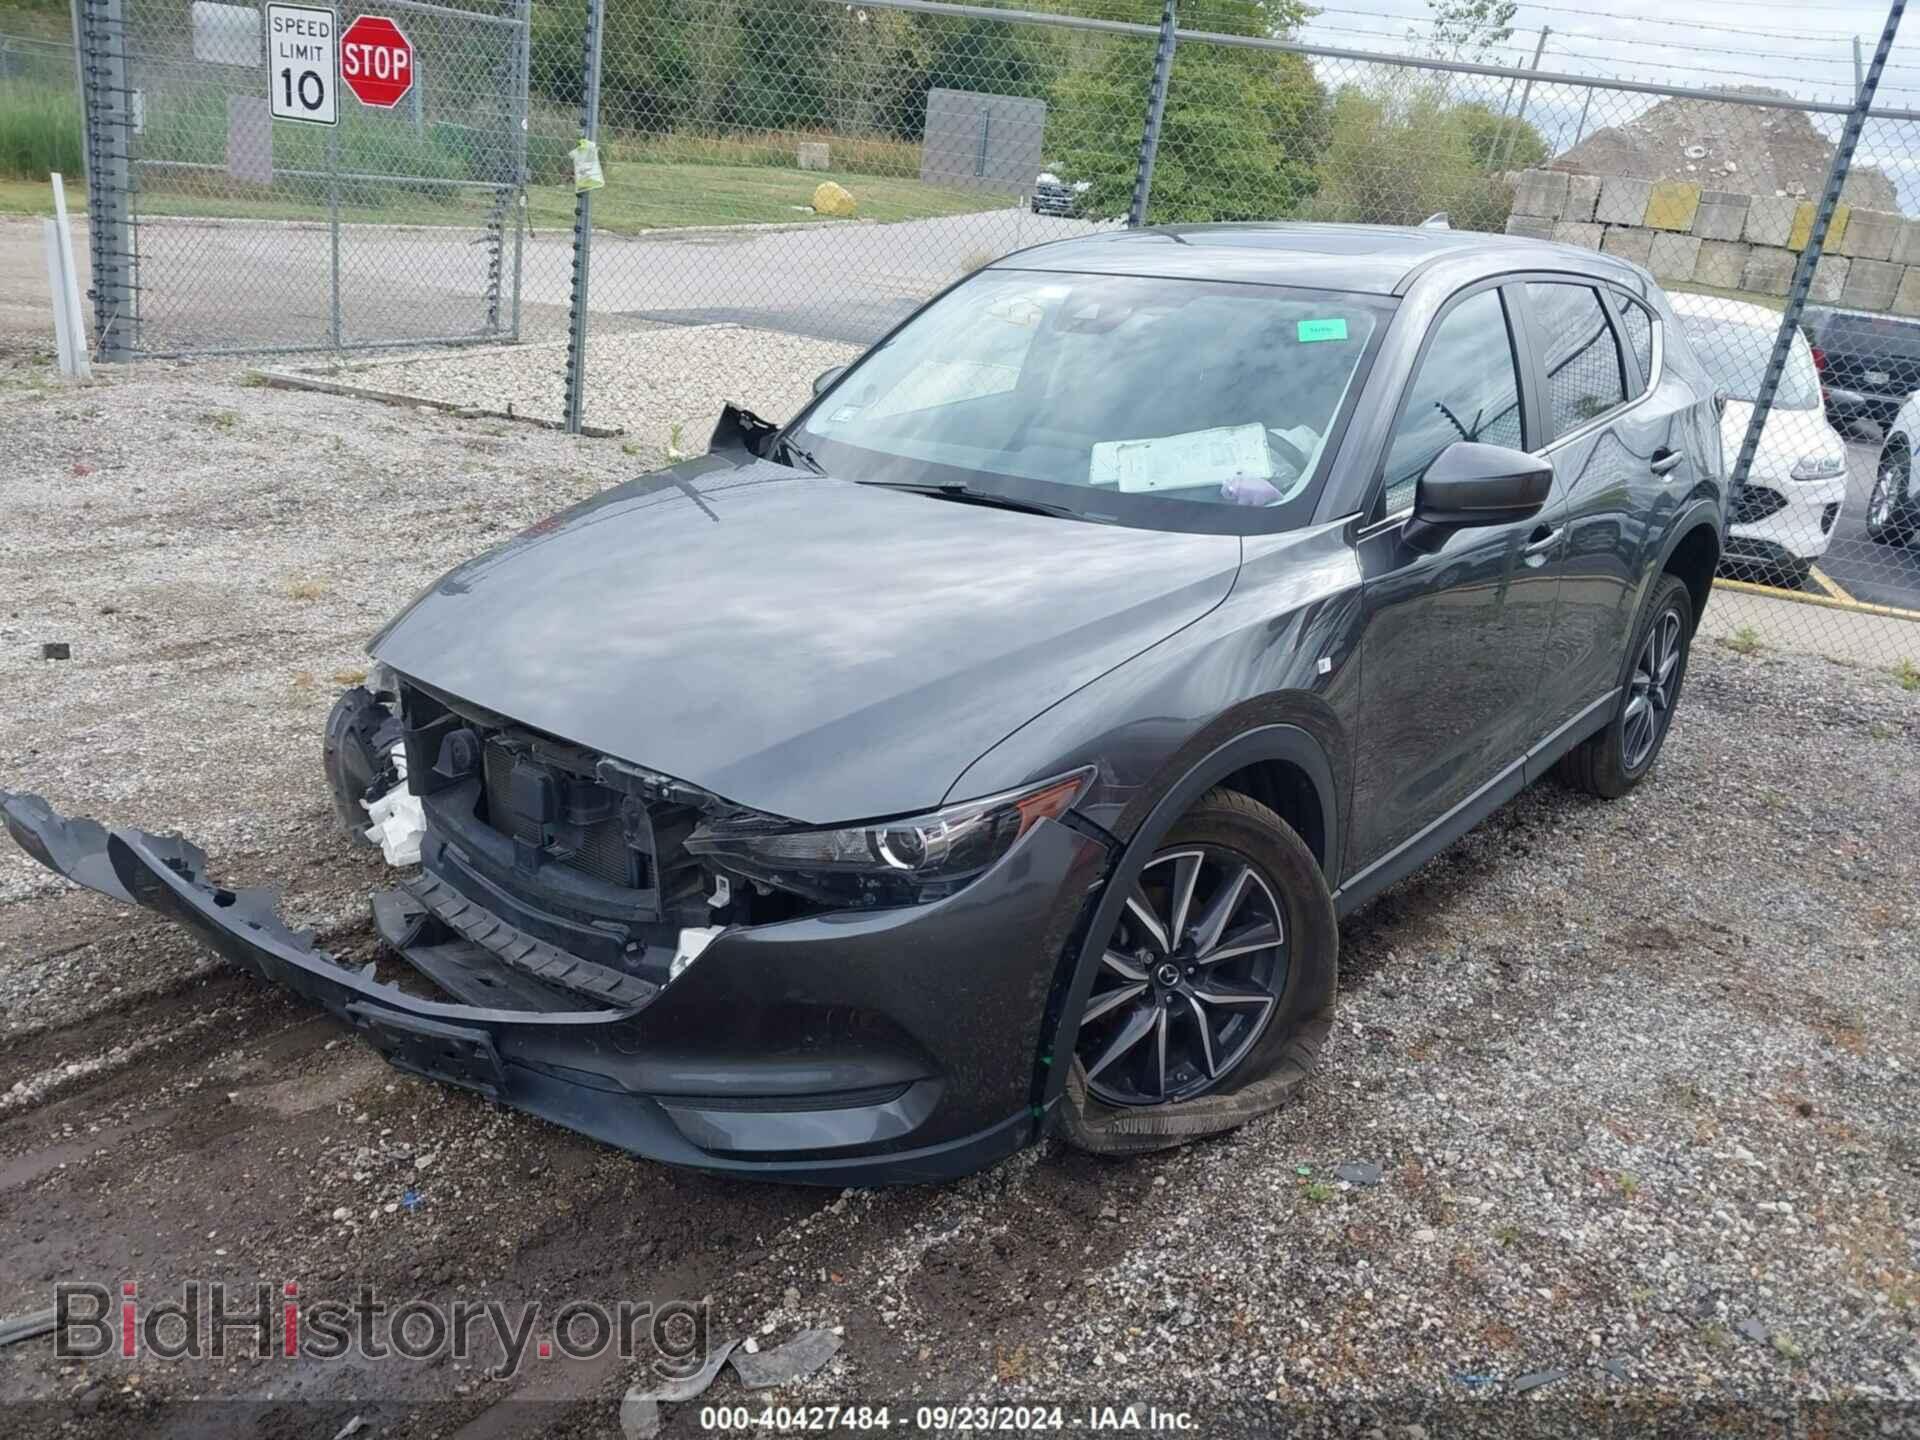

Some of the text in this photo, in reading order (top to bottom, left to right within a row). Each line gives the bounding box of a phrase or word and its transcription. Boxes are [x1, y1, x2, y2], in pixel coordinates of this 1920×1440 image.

[273, 17, 330, 38] SPEED
[280, 42, 323, 62] LIMIT
[345, 43, 408, 81] STOP
[281, 67, 325, 111] 10
